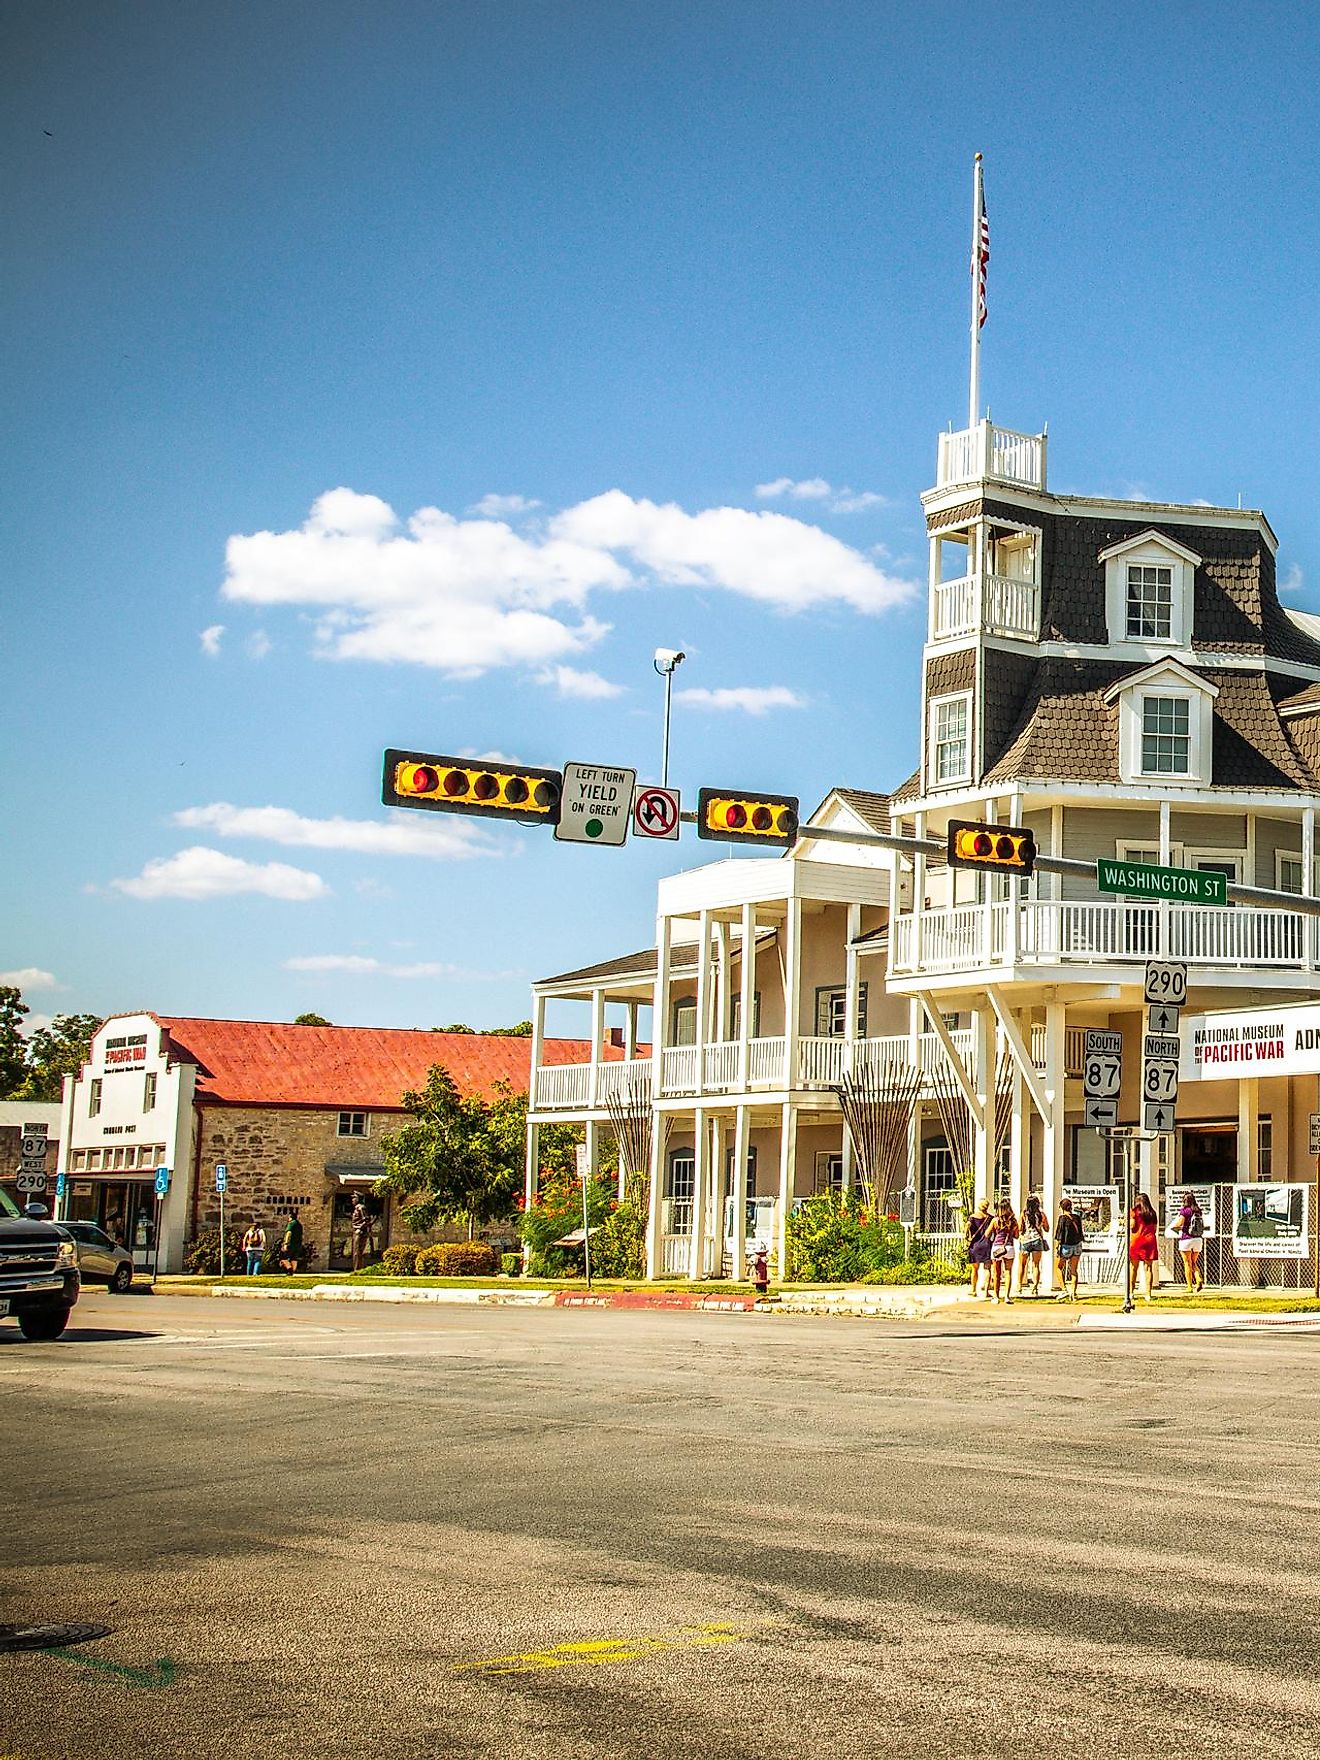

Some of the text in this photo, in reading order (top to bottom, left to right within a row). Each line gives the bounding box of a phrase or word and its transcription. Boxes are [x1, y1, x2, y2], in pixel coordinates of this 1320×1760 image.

[576, 768, 625, 783] LEFT TURN
[579, 783, 617, 801] YIELD
[571, 802, 619, 816] ON GREEN
[1104, 867, 1220, 897] WASHINGTON ST
[1148, 970, 1182, 995] 290
[1088, 1033, 1120, 1050] SOUTH
[1194, 1023, 1284, 1044] NATIONAL MUSEUM
[1146, 1038, 1178, 1055] NORTH
[1194, 1046, 1203, 1056] OF
[1204, 1040, 1284, 1063] PACIFIC WAR
[1088, 1062, 1117, 1087] 87
[1147, 1068, 1175, 1093] 87
[25, 1123, 46, 1132] NORTH
[26, 1139, 44, 1151] 87
[19, 1176, 44, 1187] 290
